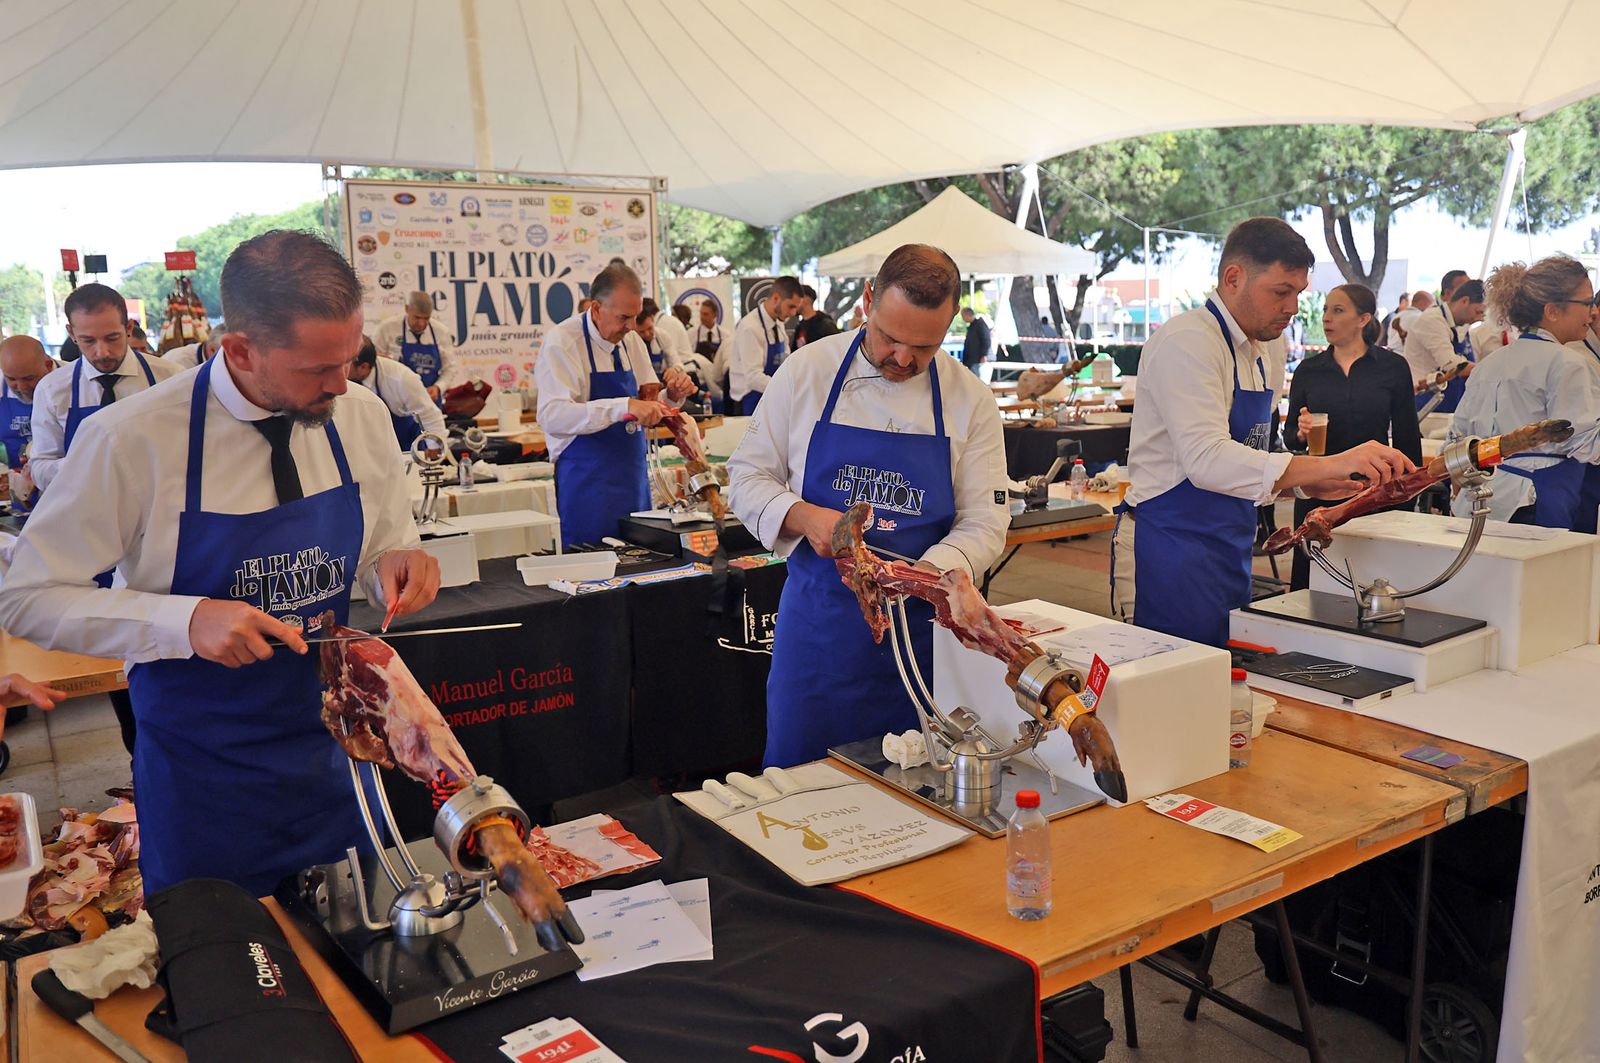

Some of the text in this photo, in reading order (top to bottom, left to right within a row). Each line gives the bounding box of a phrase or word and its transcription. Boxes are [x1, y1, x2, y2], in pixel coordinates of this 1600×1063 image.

[394, 228, 442, 238] Cruzcampo
[467, 251, 556, 278] PLATO
[500, 328, 544, 341] grande
[832, 468, 926, 512] de JAMÓN
[861, 467, 904, 486] PLATO
[268, 546, 321, 576] PLATO
[230, 552, 346, 614] de JAMÓN
[431, 662, 574, 704] Manuel García
[445, 691, 575, 728] ORTADOR DE JAMÓN
[248, 942, 278, 987] Claveles
[434, 987, 482, 1012] Vicente
[536, 1040, 574, 1060] 1941
